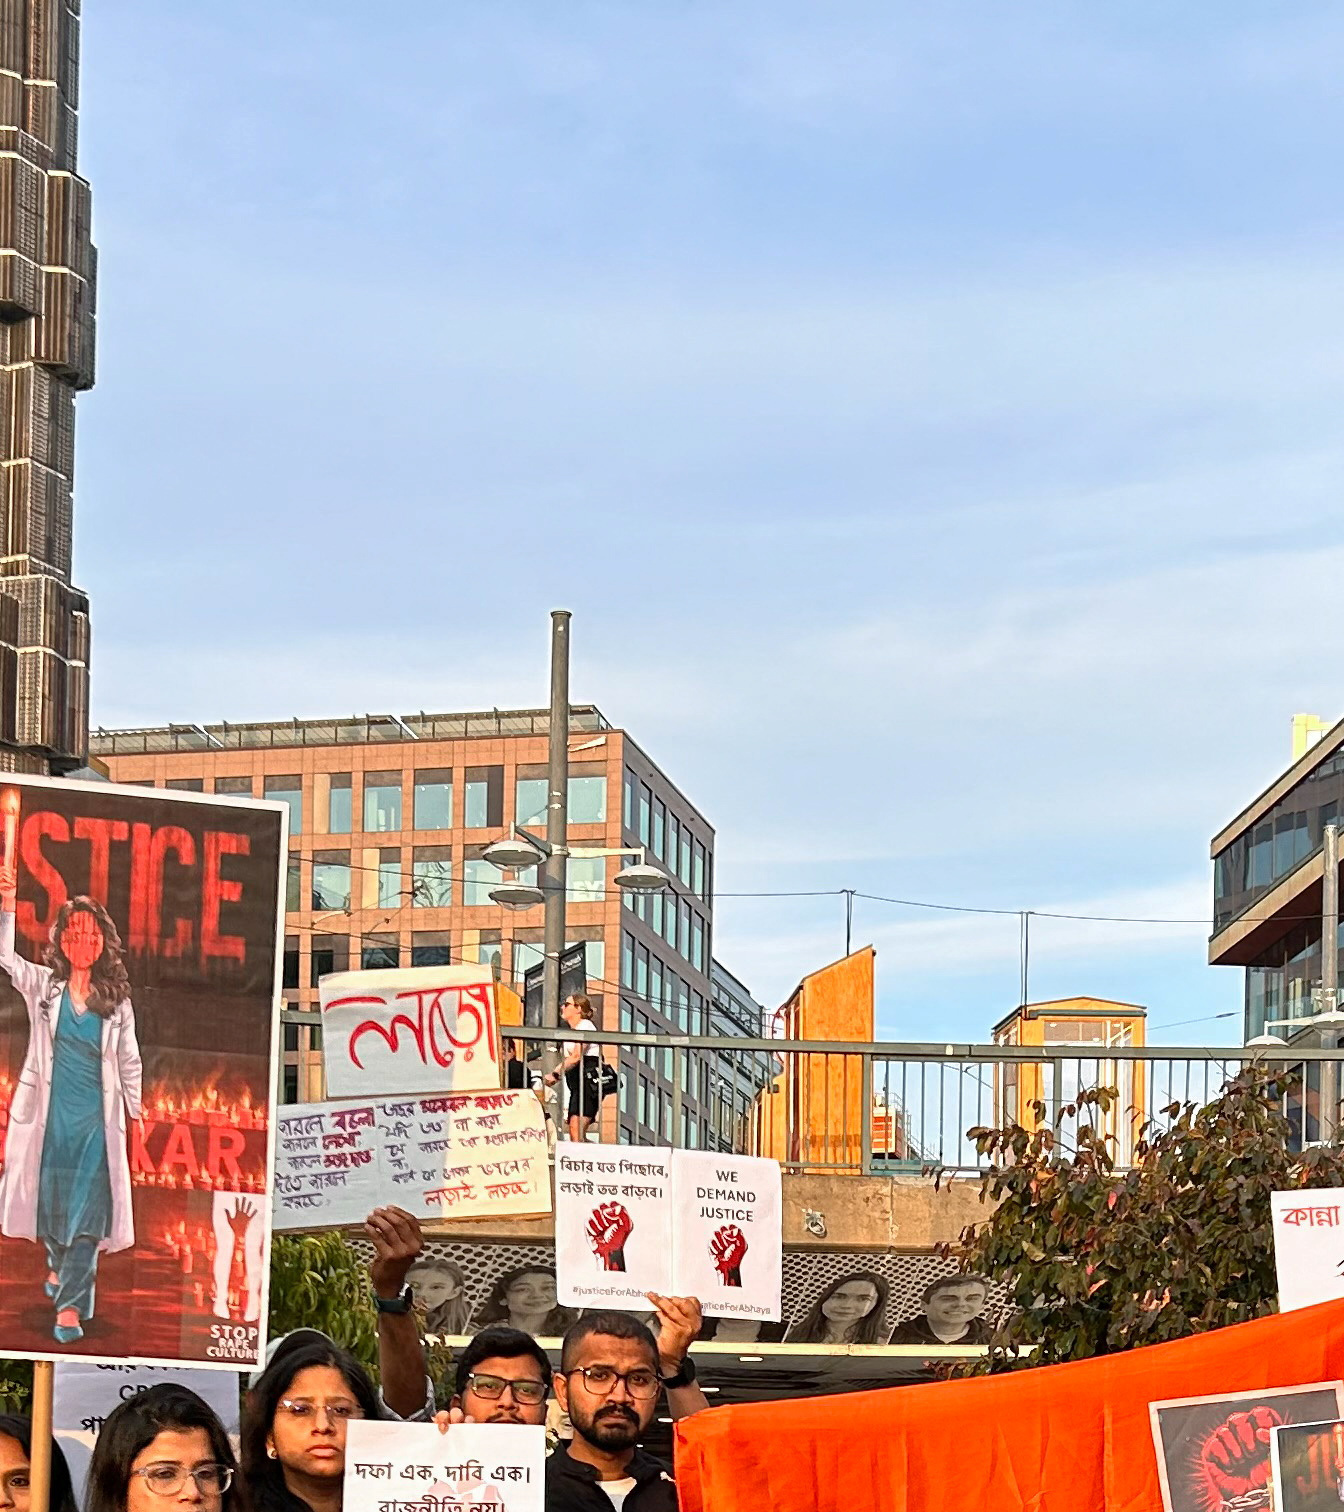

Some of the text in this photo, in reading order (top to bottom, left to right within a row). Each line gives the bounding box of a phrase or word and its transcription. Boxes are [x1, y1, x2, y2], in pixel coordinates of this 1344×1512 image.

[130, 1119, 247, 1178] KAR
[560, 1156, 594, 1174] বিচার
[597, 1161, 616, 1173] যত
[716, 1170, 739, 1183] WE
[560, 1180, 663, 1200] লড়াই তত বাড়বে।
[696, 1187, 756, 1203] DEMAND
[699, 1206, 754, 1222] JUSTICE
[1281, 1205, 1341, 1228] কান্না
[210, 1324, 258, 1342] STOP
[206, 1346, 259, 1360] CULTURE
[218, 1338, 250, 1350] RAPE
[354, 1460, 531, 1484] দফা এক, দাবি এক।
